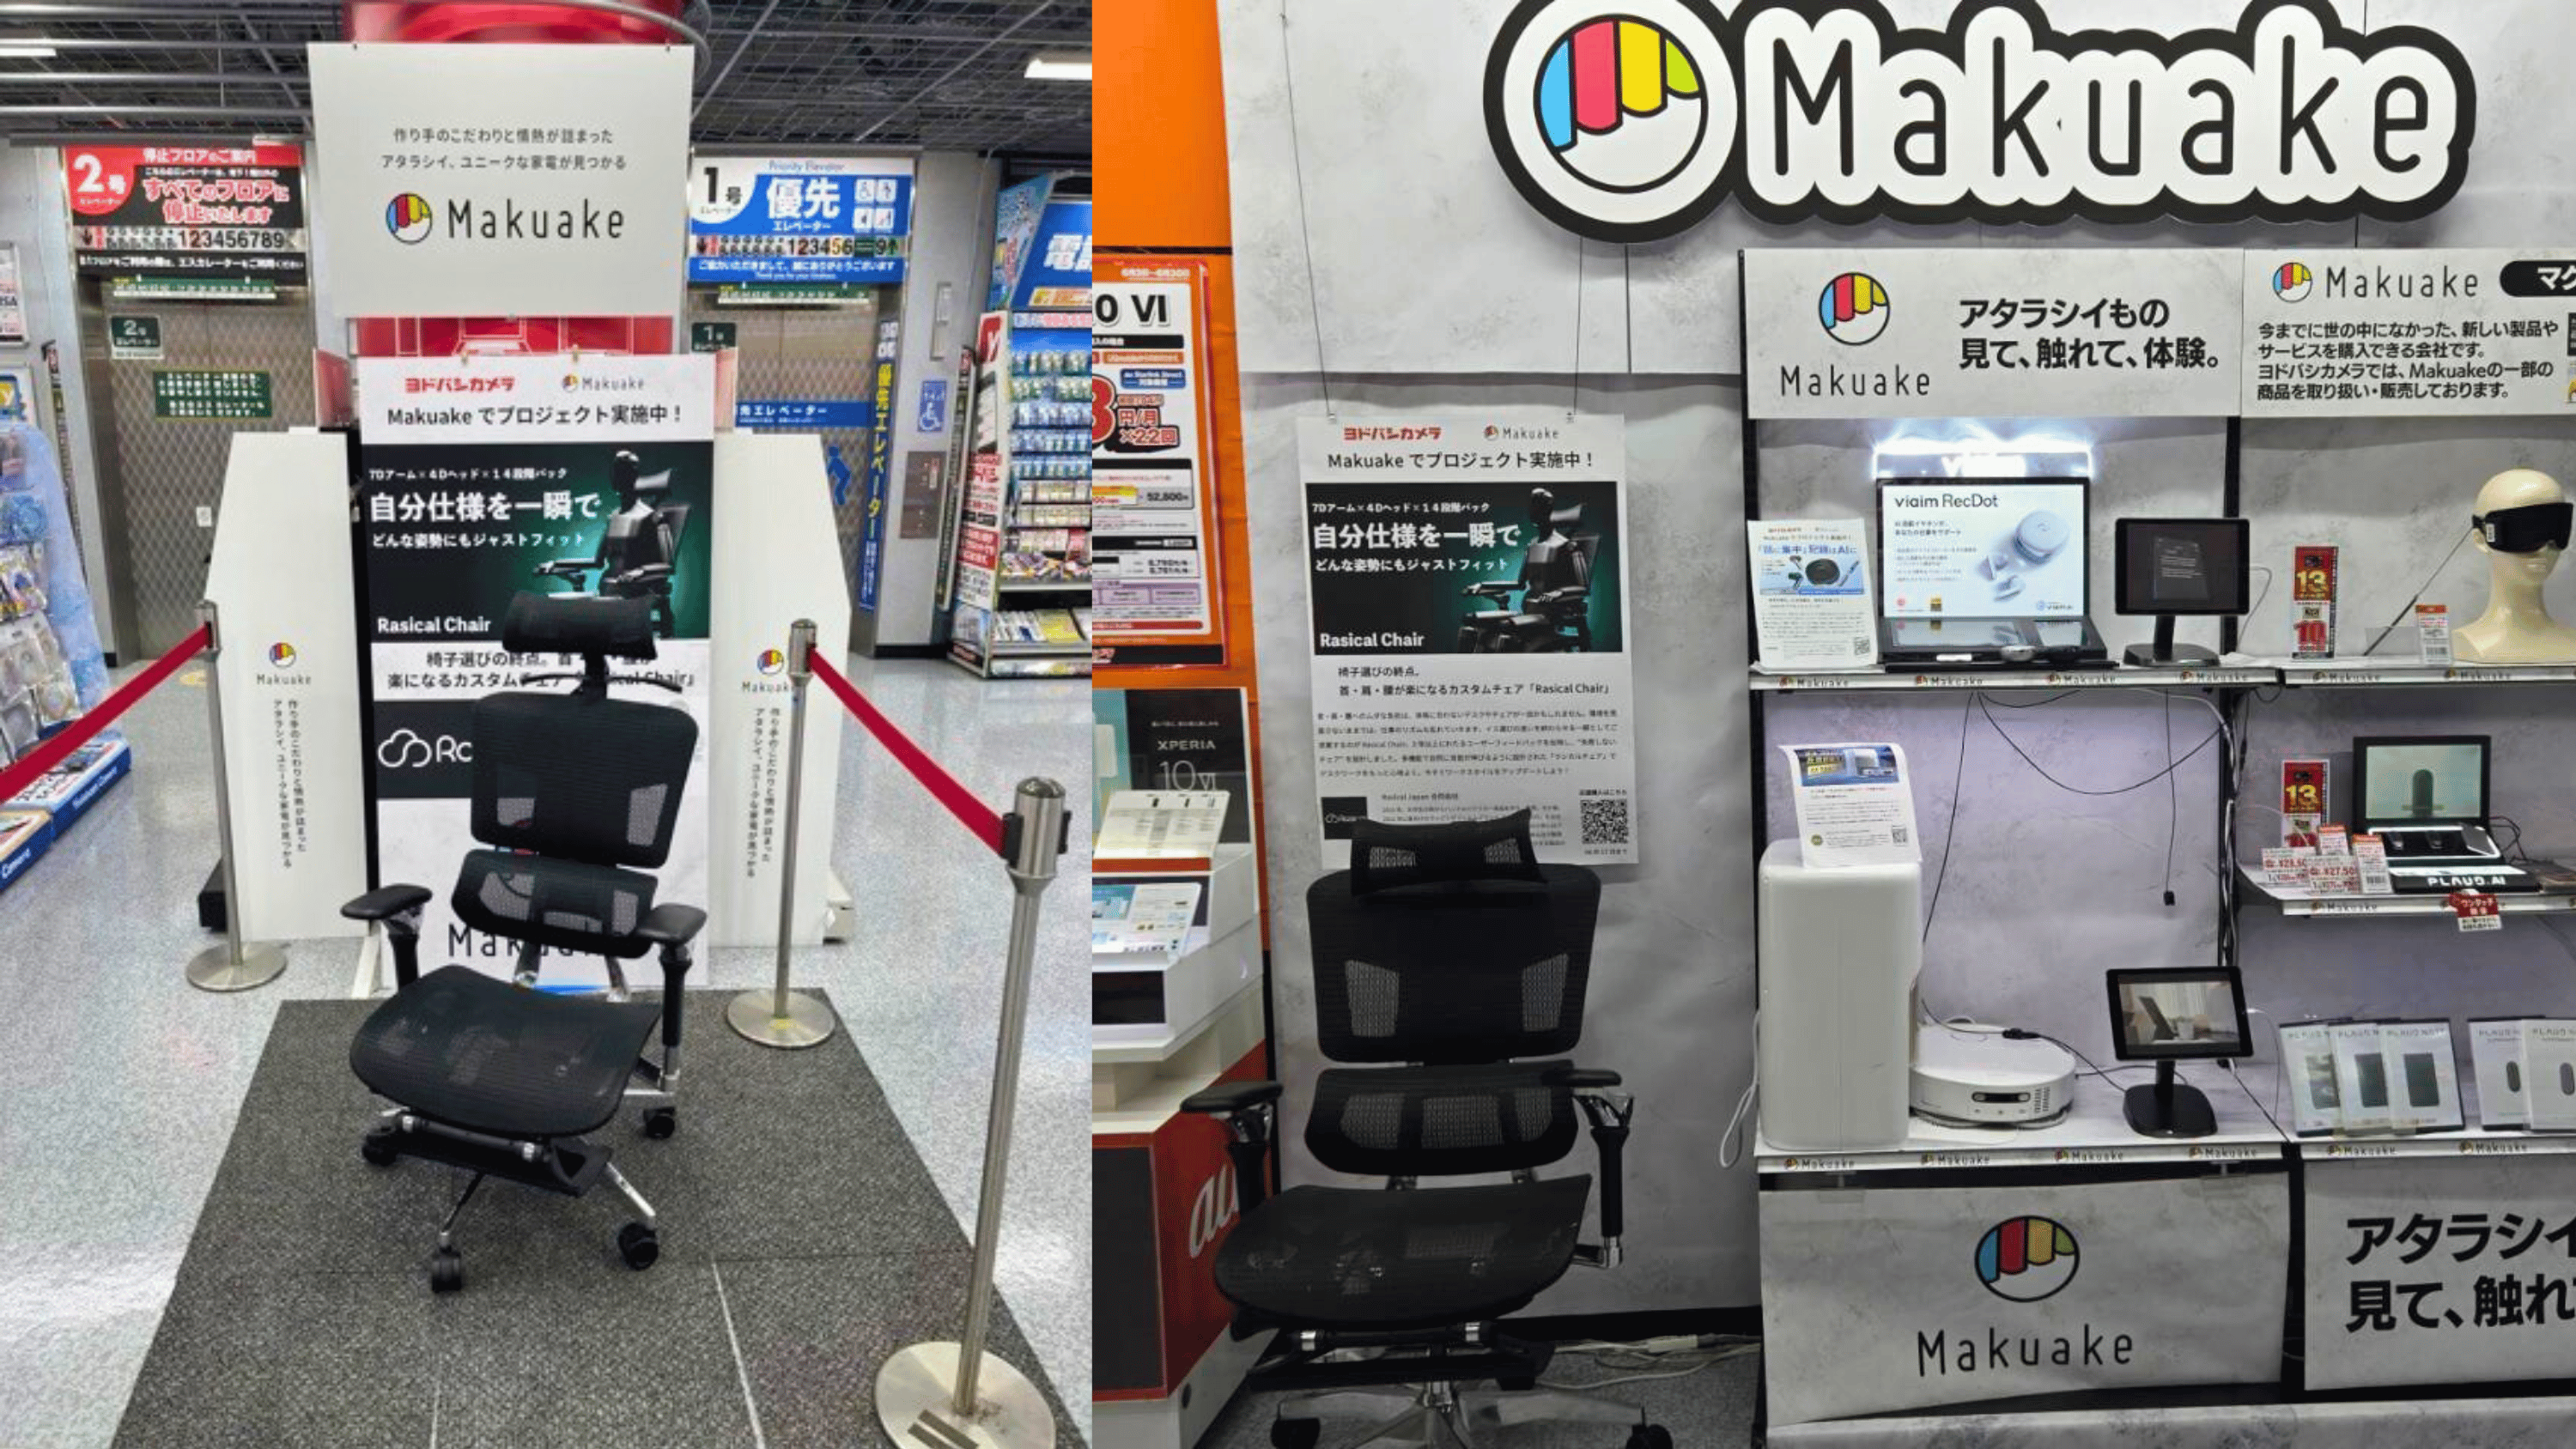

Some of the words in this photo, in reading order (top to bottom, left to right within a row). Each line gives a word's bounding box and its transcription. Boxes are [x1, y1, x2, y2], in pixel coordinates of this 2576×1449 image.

[1771, 33, 2429, 177] Makuake
[392, 128, 613, 144] 作り手のこだわりと情熱が詰まった
[381, 154, 628, 171] アタラシイ、ユニークな家電が見つかる
[142, 176, 290, 203] すべてのフロアに
[766, 176, 841, 220] 優先
[161, 198, 273, 225] 停止いたします
[447, 198, 625, 239] Makuake
[772, 220, 832, 233] エレベーター
[2324, 264, 2479, 299] Makuake
[1130, 294, 1168, 324] VI
[1958, 298, 2171, 330] アタラシイもの
[2257, 320, 2559, 340] 今までに世の中になかった、新しい製品や
[1958, 337, 2221, 370] 見て、触れて、体験。
[2257, 342, 2485, 360] サービスを購入できる会社です。
[2257, 361, 2555, 379] ヨドバシカメラでは、Makuakeの一部の
[404, 377, 516, 393] ヨドバシカメラ
[581, 376, 646, 391] Makuake
[1780, 363, 1931, 397] Makuake
[2257, 382, 2509, 401] 商品を取り扱い・販売しております。
[387, 408, 473, 427] Makuake
[479, 404, 682, 426] でプロジェクト実施中！
[1343, 427, 1443, 441] ヨドバシカメラ
[1502, 427, 1560, 440] Makuake
[1327, 452, 1405, 469] Makuake
[1412, 450, 1593, 469] でプロジェクト実施中！
[369, 490, 602, 523] 自分仕様を一瞬で
[1894, 494, 1940, 508] viaim
[1941, 493, 2000, 508] RecDot
[372, 532, 585, 550] どんな姿勢にもジャストフィット
[1313, 522, 1522, 549] 自分仕様を一瞬で
[1315, 558, 1508, 573] どんな姿勢にもジャストフィット
[377, 617, 441, 634] Rasical
[443, 615, 492, 634] Chair
[1320, 633, 1378, 648] Rasical
[1380, 631, 1425, 648] Chair
[257, 673, 313, 685] Makuake
[1337, 665, 1420, 679] 椅子選びの終点。
[741, 681, 793, 693] Makuak
[1157, 739, 1216, 752] XPERIA
[2345, 1212, 2576, 1265] アタラシイ
[2345, 1273, 2576, 1334] 見て、触れ
[1917, 1323, 2135, 1379] Makuake
